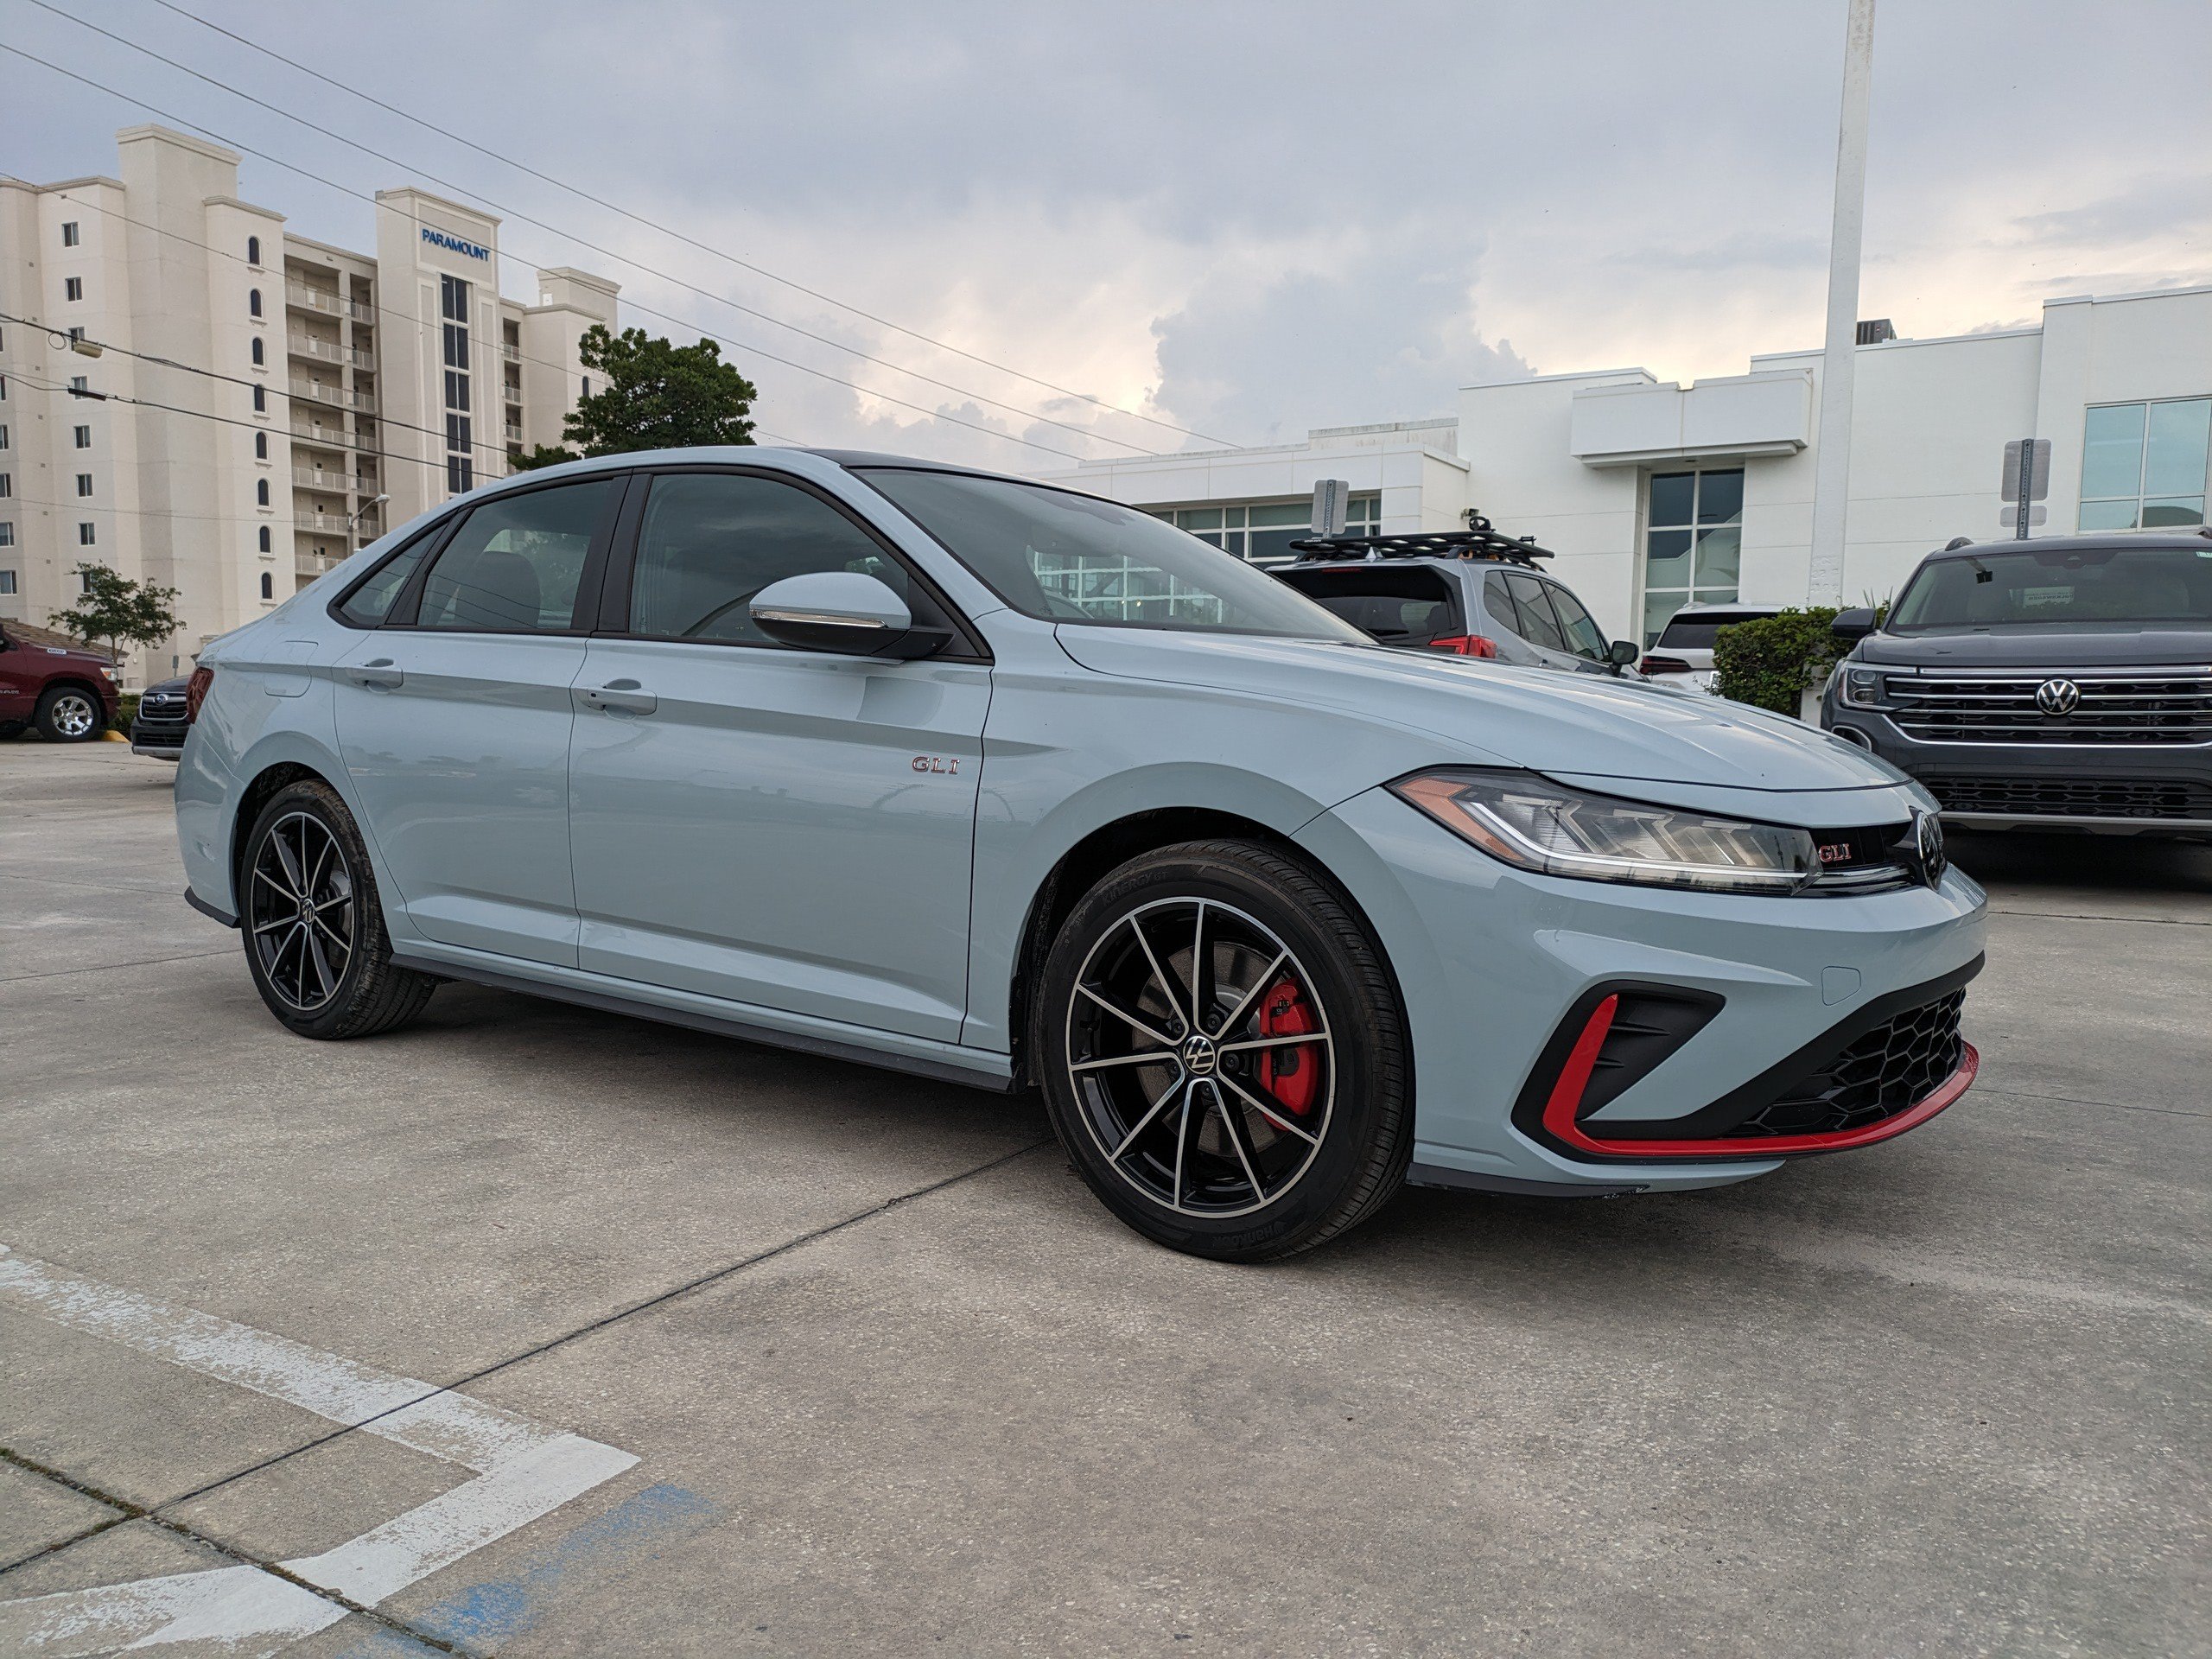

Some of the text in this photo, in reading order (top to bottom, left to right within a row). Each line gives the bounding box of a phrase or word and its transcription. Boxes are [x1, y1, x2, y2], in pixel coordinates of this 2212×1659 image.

[422, 228, 491, 262] PARAMOUNT
[912, 756, 961, 775] GLI
[1819, 843, 1852, 862] GLI
